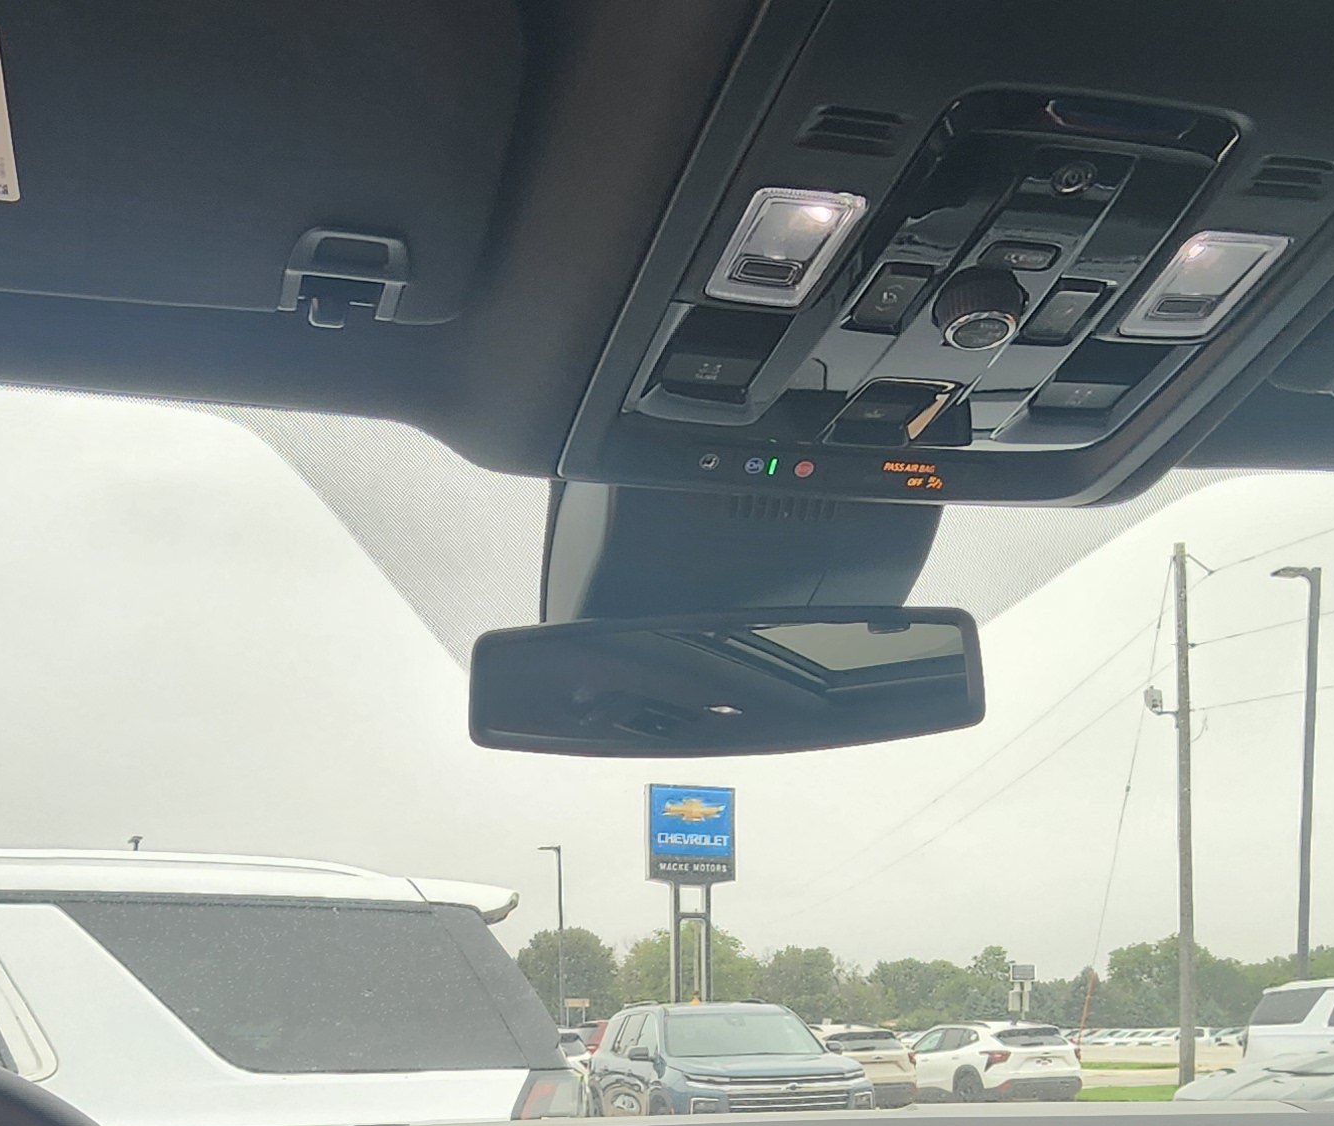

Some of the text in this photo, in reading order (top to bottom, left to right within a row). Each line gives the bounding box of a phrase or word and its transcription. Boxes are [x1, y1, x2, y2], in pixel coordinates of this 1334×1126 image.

[883, 462, 936, 474] PASS AIR BAG
[907, 477, 924, 487] OFF
[657, 832, 729, 847] CHEVROLET
[693, 863, 727, 873] MOTORS
